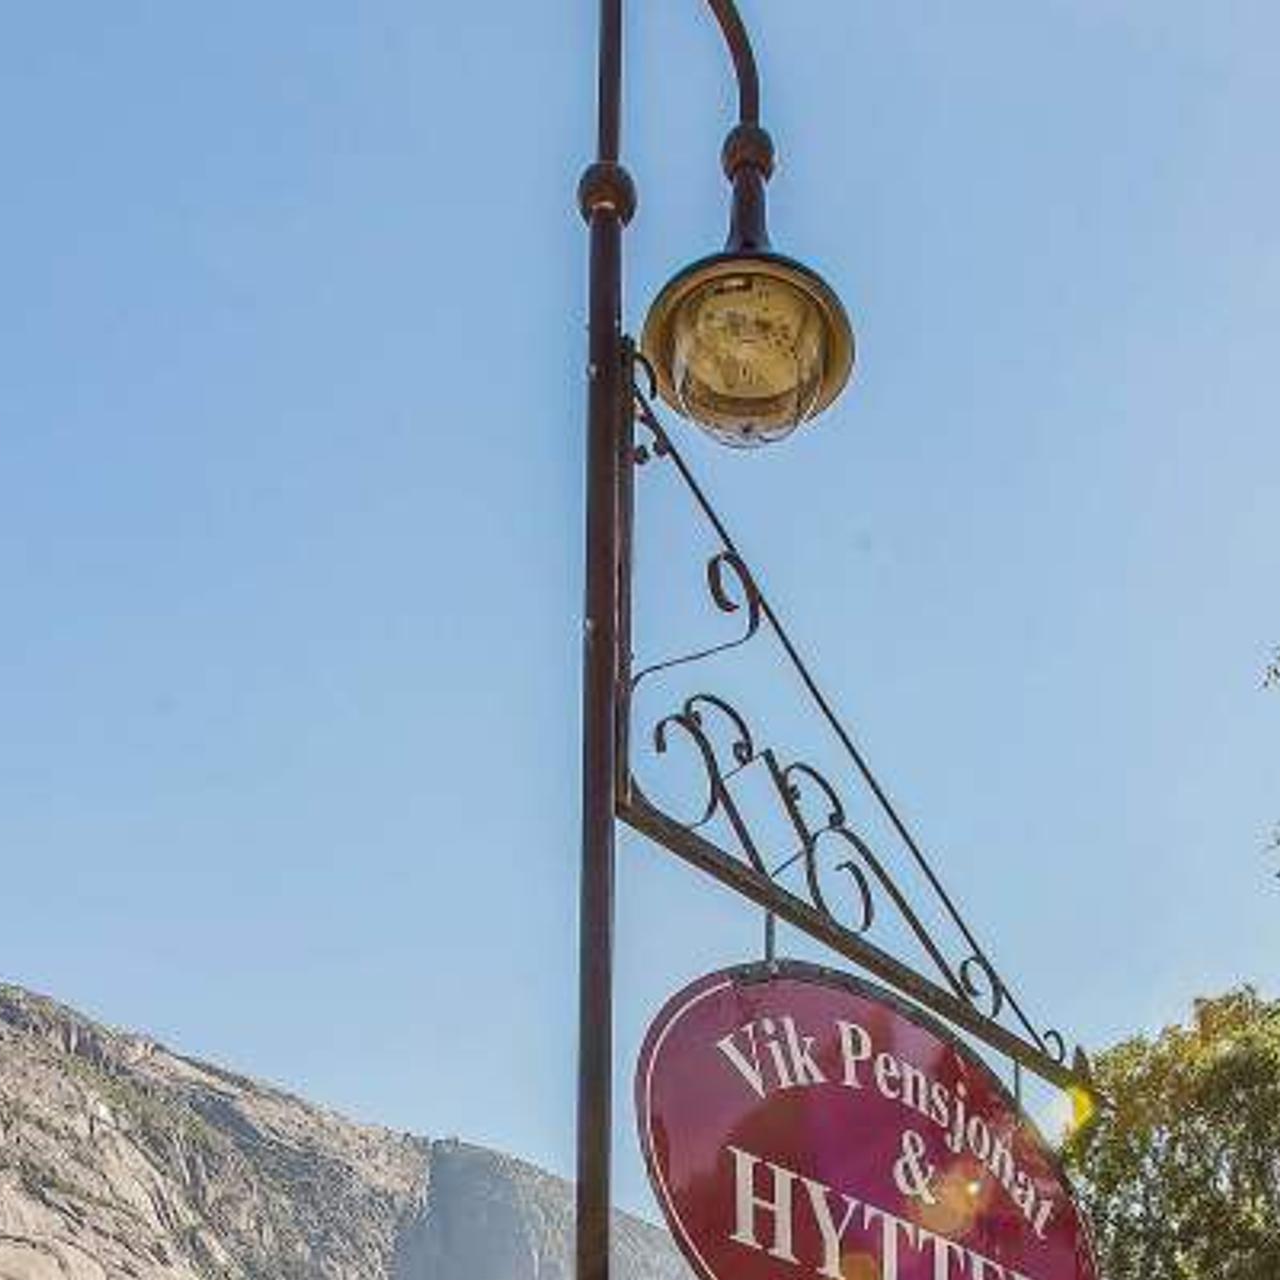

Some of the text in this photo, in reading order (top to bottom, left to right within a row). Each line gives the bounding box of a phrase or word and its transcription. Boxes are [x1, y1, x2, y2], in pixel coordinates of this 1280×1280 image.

[716, 1015, 1054, 1240] Vik Pensjonat
[892, 1128, 936, 1205] &
